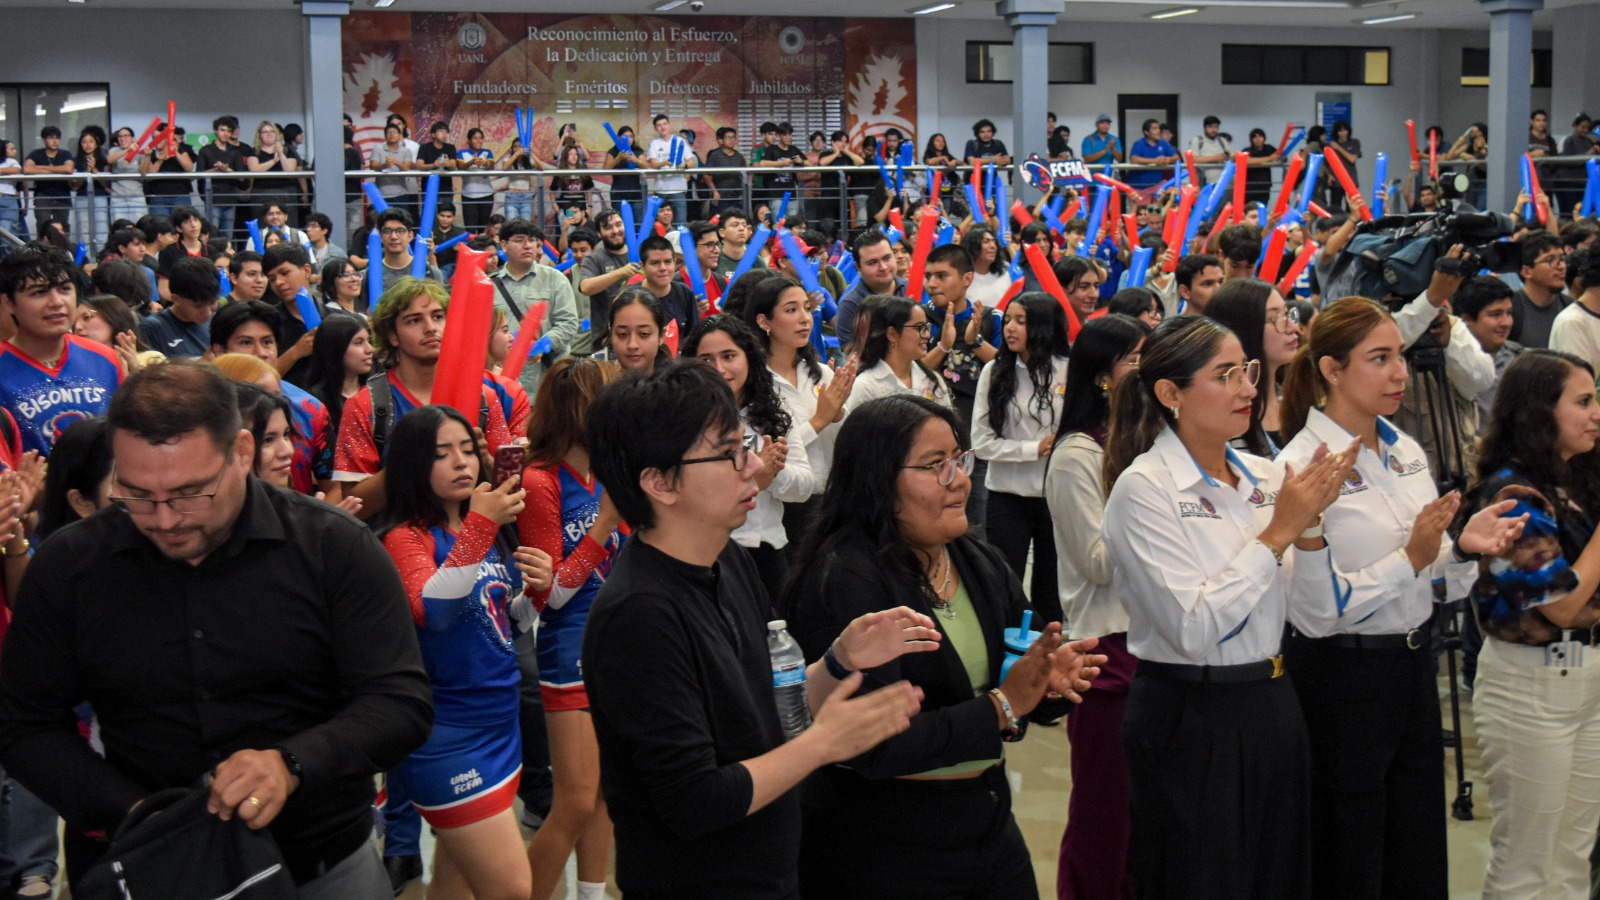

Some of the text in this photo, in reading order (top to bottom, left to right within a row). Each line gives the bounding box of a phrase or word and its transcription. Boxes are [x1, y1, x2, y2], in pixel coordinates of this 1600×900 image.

[528, 26, 738, 43] Reconocimiento al Esfuerzo,
[458, 54, 488, 63] UANL
[546, 48, 721, 66] la Dedicación y Entrega
[453, 80, 537, 94] Fundadores
[565, 79, 628, 94] Eméritos
[650, 80, 720, 94] Directores
[749, 80, 812, 94] Jubilados
[1049, 160, 1085, 178] FCFM
[17, 387, 104, 420] BISONTES
